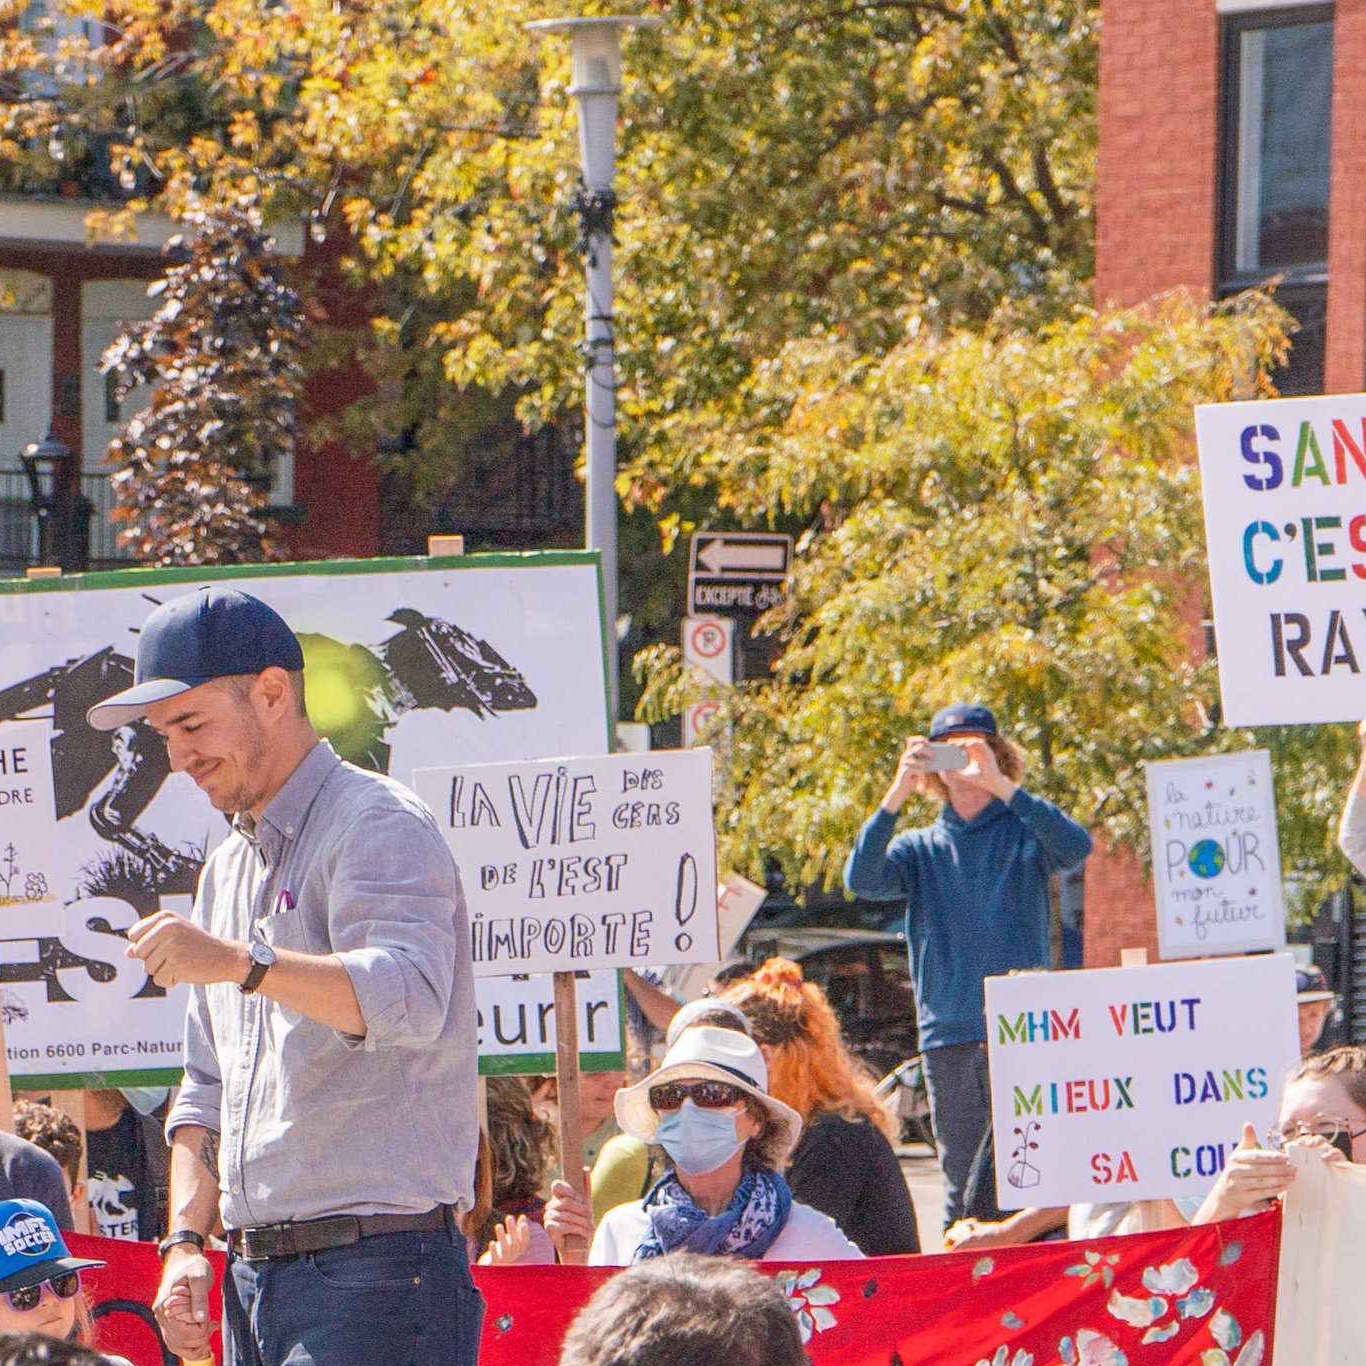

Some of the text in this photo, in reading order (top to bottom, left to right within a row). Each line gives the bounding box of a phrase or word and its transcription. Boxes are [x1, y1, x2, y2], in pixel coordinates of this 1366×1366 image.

[450, 775, 502, 828] LA
[1173, 800, 1262, 830] nature
[1166, 831, 1265, 882] POUR
[480, 854, 628, 900] DE L'EST
[1172, 885, 1224, 901] mon
[998, 998, 1201, 1045] MHM VEUT
[46, 1043, 86, 1058] 6600
[91, 1040, 184, 1057] Parc-Natur
[1013, 1067, 1269, 1117] MIEUX DANS
[1091, 1151, 1139, 1185] SA
[3, 1232, 56, 1257] SOCCER
